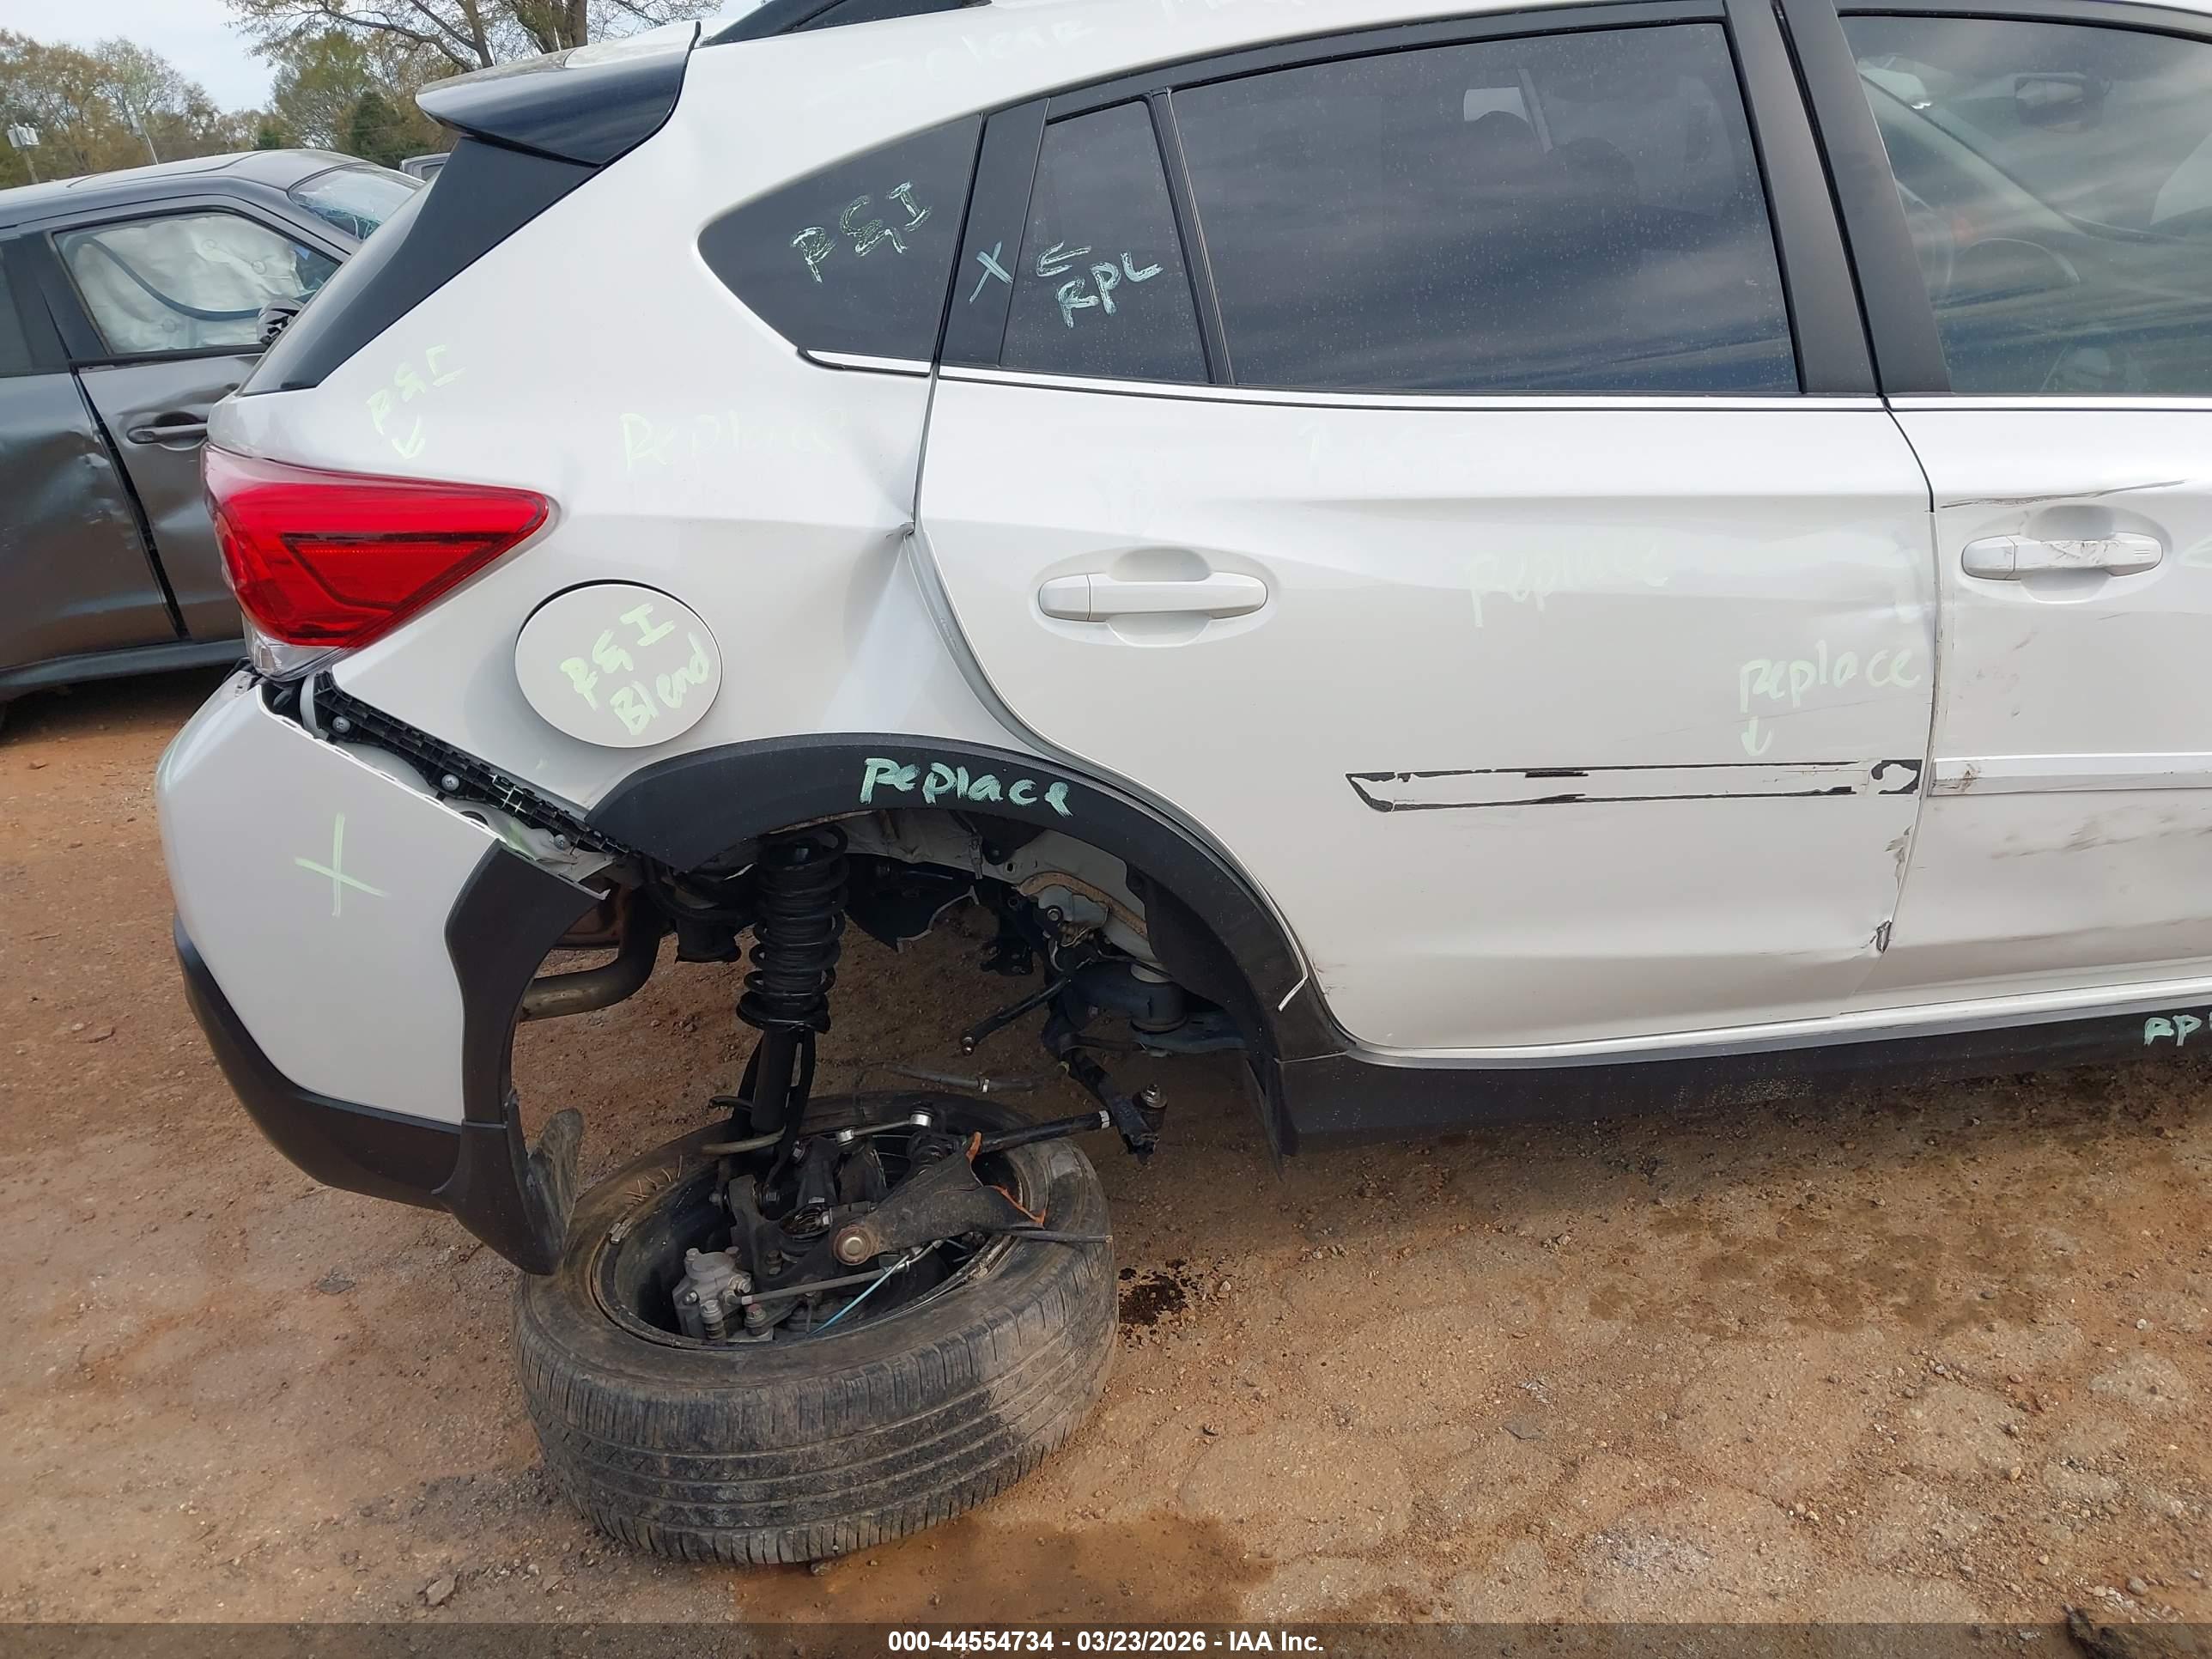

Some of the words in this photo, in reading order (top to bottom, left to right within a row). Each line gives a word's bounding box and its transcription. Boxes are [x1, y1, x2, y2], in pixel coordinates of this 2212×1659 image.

[1055, 251, 1163, 328] RPL
[610, 631, 709, 735] Blend
[2144, 1012, 2212, 1046] RP
